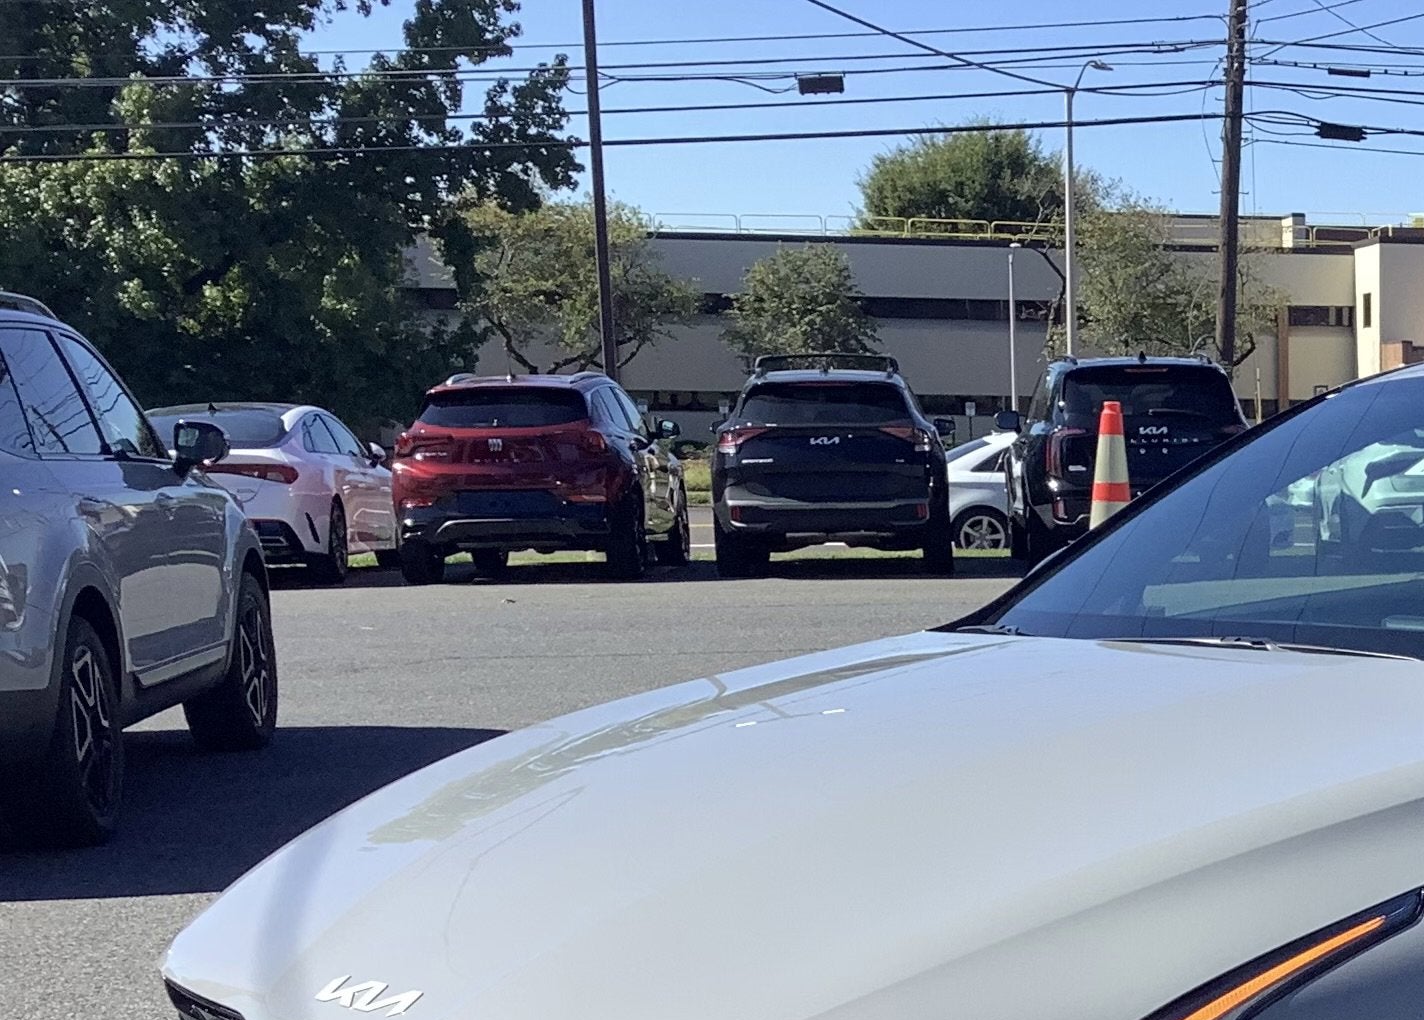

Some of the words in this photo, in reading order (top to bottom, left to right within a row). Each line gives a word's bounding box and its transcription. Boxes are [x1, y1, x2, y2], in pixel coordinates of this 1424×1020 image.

[1139, 427, 1168, 435] KIA
[809, 436, 840, 445] KIA
[314, 974, 424, 1018] KIA
